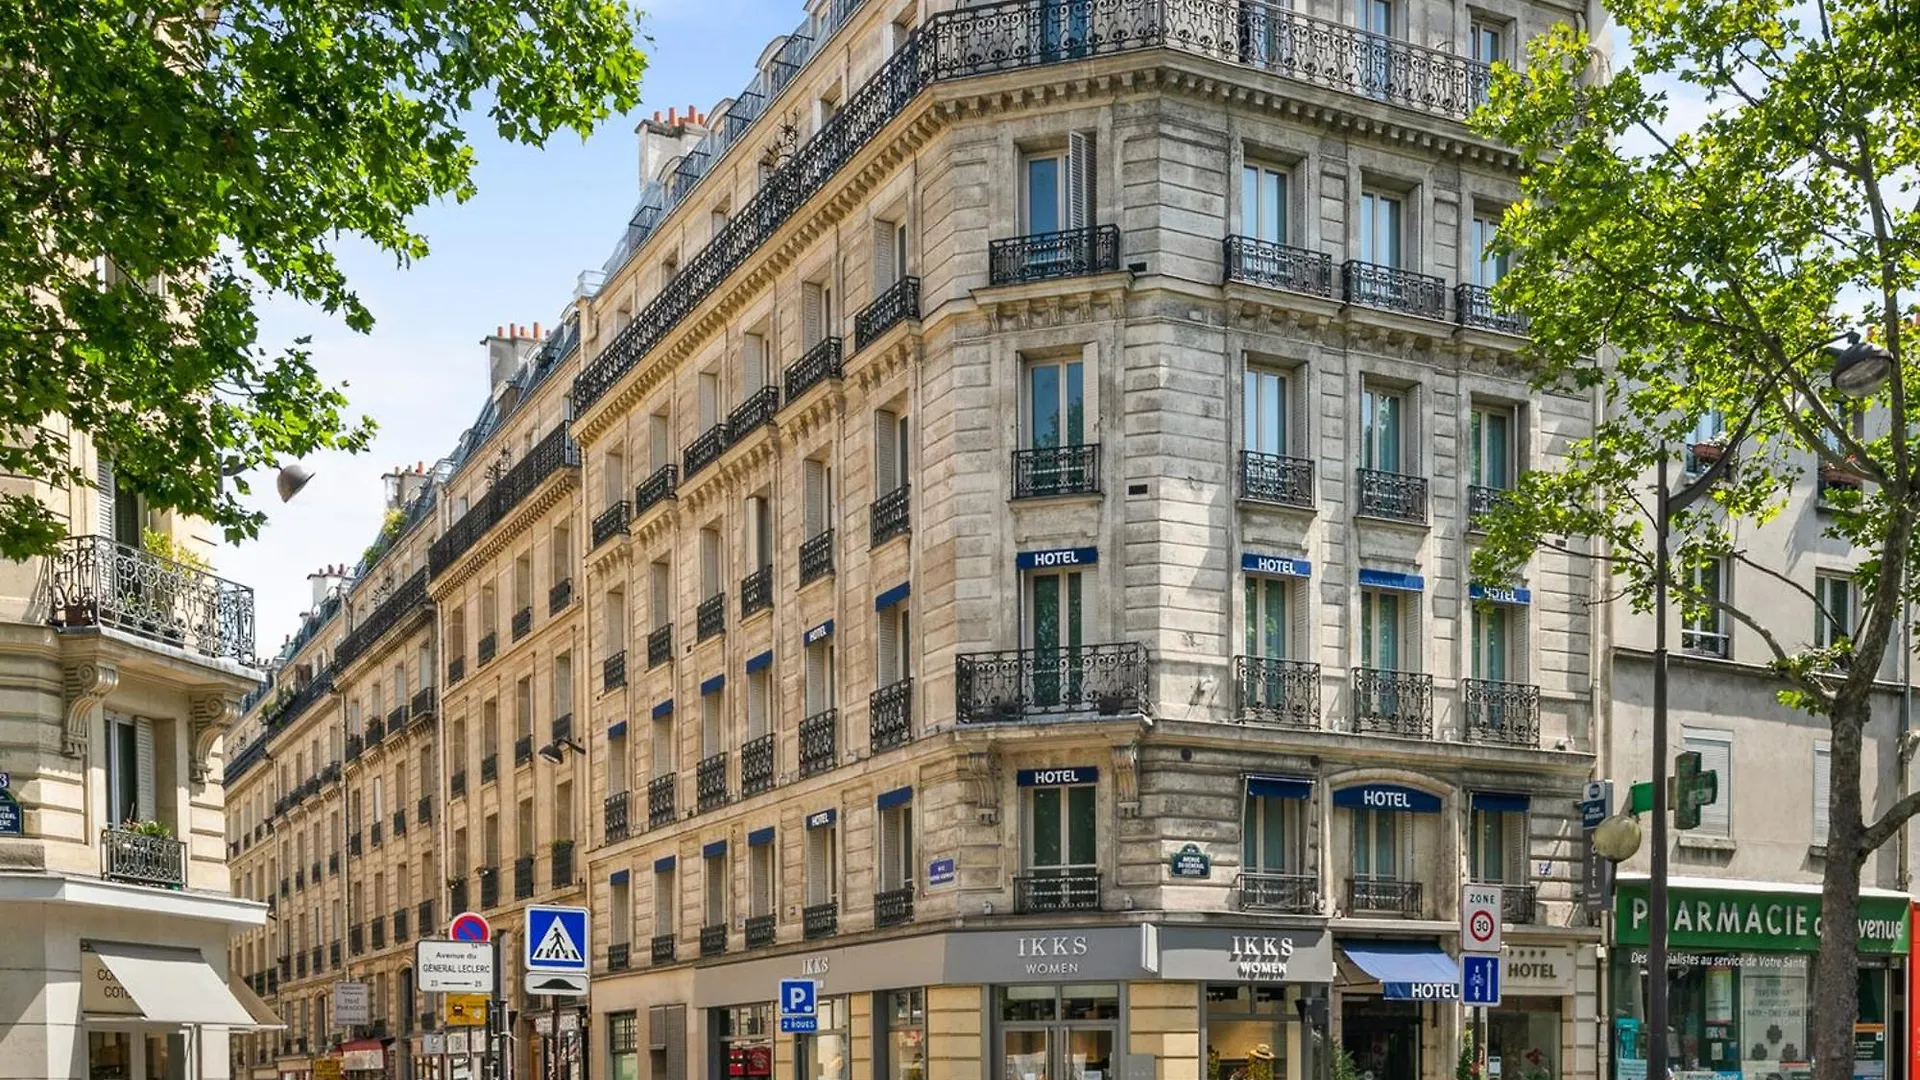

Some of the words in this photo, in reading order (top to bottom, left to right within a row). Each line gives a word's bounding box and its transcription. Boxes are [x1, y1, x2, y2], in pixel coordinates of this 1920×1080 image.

[1034, 551, 1079, 566] HOTEL
[1258, 557, 1296, 574] HOTEL
[809, 625, 827, 641] HOTEL
[1034, 770, 1079, 784] HOTEL
[1363, 790, 1411, 808] HOTEL
[811, 812, 829, 826] HOTEL
[1469, 894, 1496, 904] ZONE
[1476, 920, 1489, 932] 30
[1632, 898, 1807, 935] PARMACIE
[1858, 919, 1904, 939] venue
[1017, 936, 1087, 956] IKKS
[1232, 936, 1294, 956] IKKS
[802, 957, 829, 975] IKKS
[1631, 952, 1648, 964] Des
[1701, 956, 1712, 966] au
[1714, 955, 1744, 966] service
[1745, 955, 1757, 966] de
[1759, 956, 1782, 967] Votre
[97, 969, 113, 981] CO
[458, 964, 490, 974] LECLERC
[1026, 963, 1079, 974] WOMEN
[1240, 962, 1287, 973] WOMEN
[1508, 963, 1557, 978] HOTEL
[1412, 983, 1459, 998] HOTEL
[790, 987, 806, 1010] P
[783, 1021, 789, 1029] 2
[791, 1020, 815, 1029] ROUES
